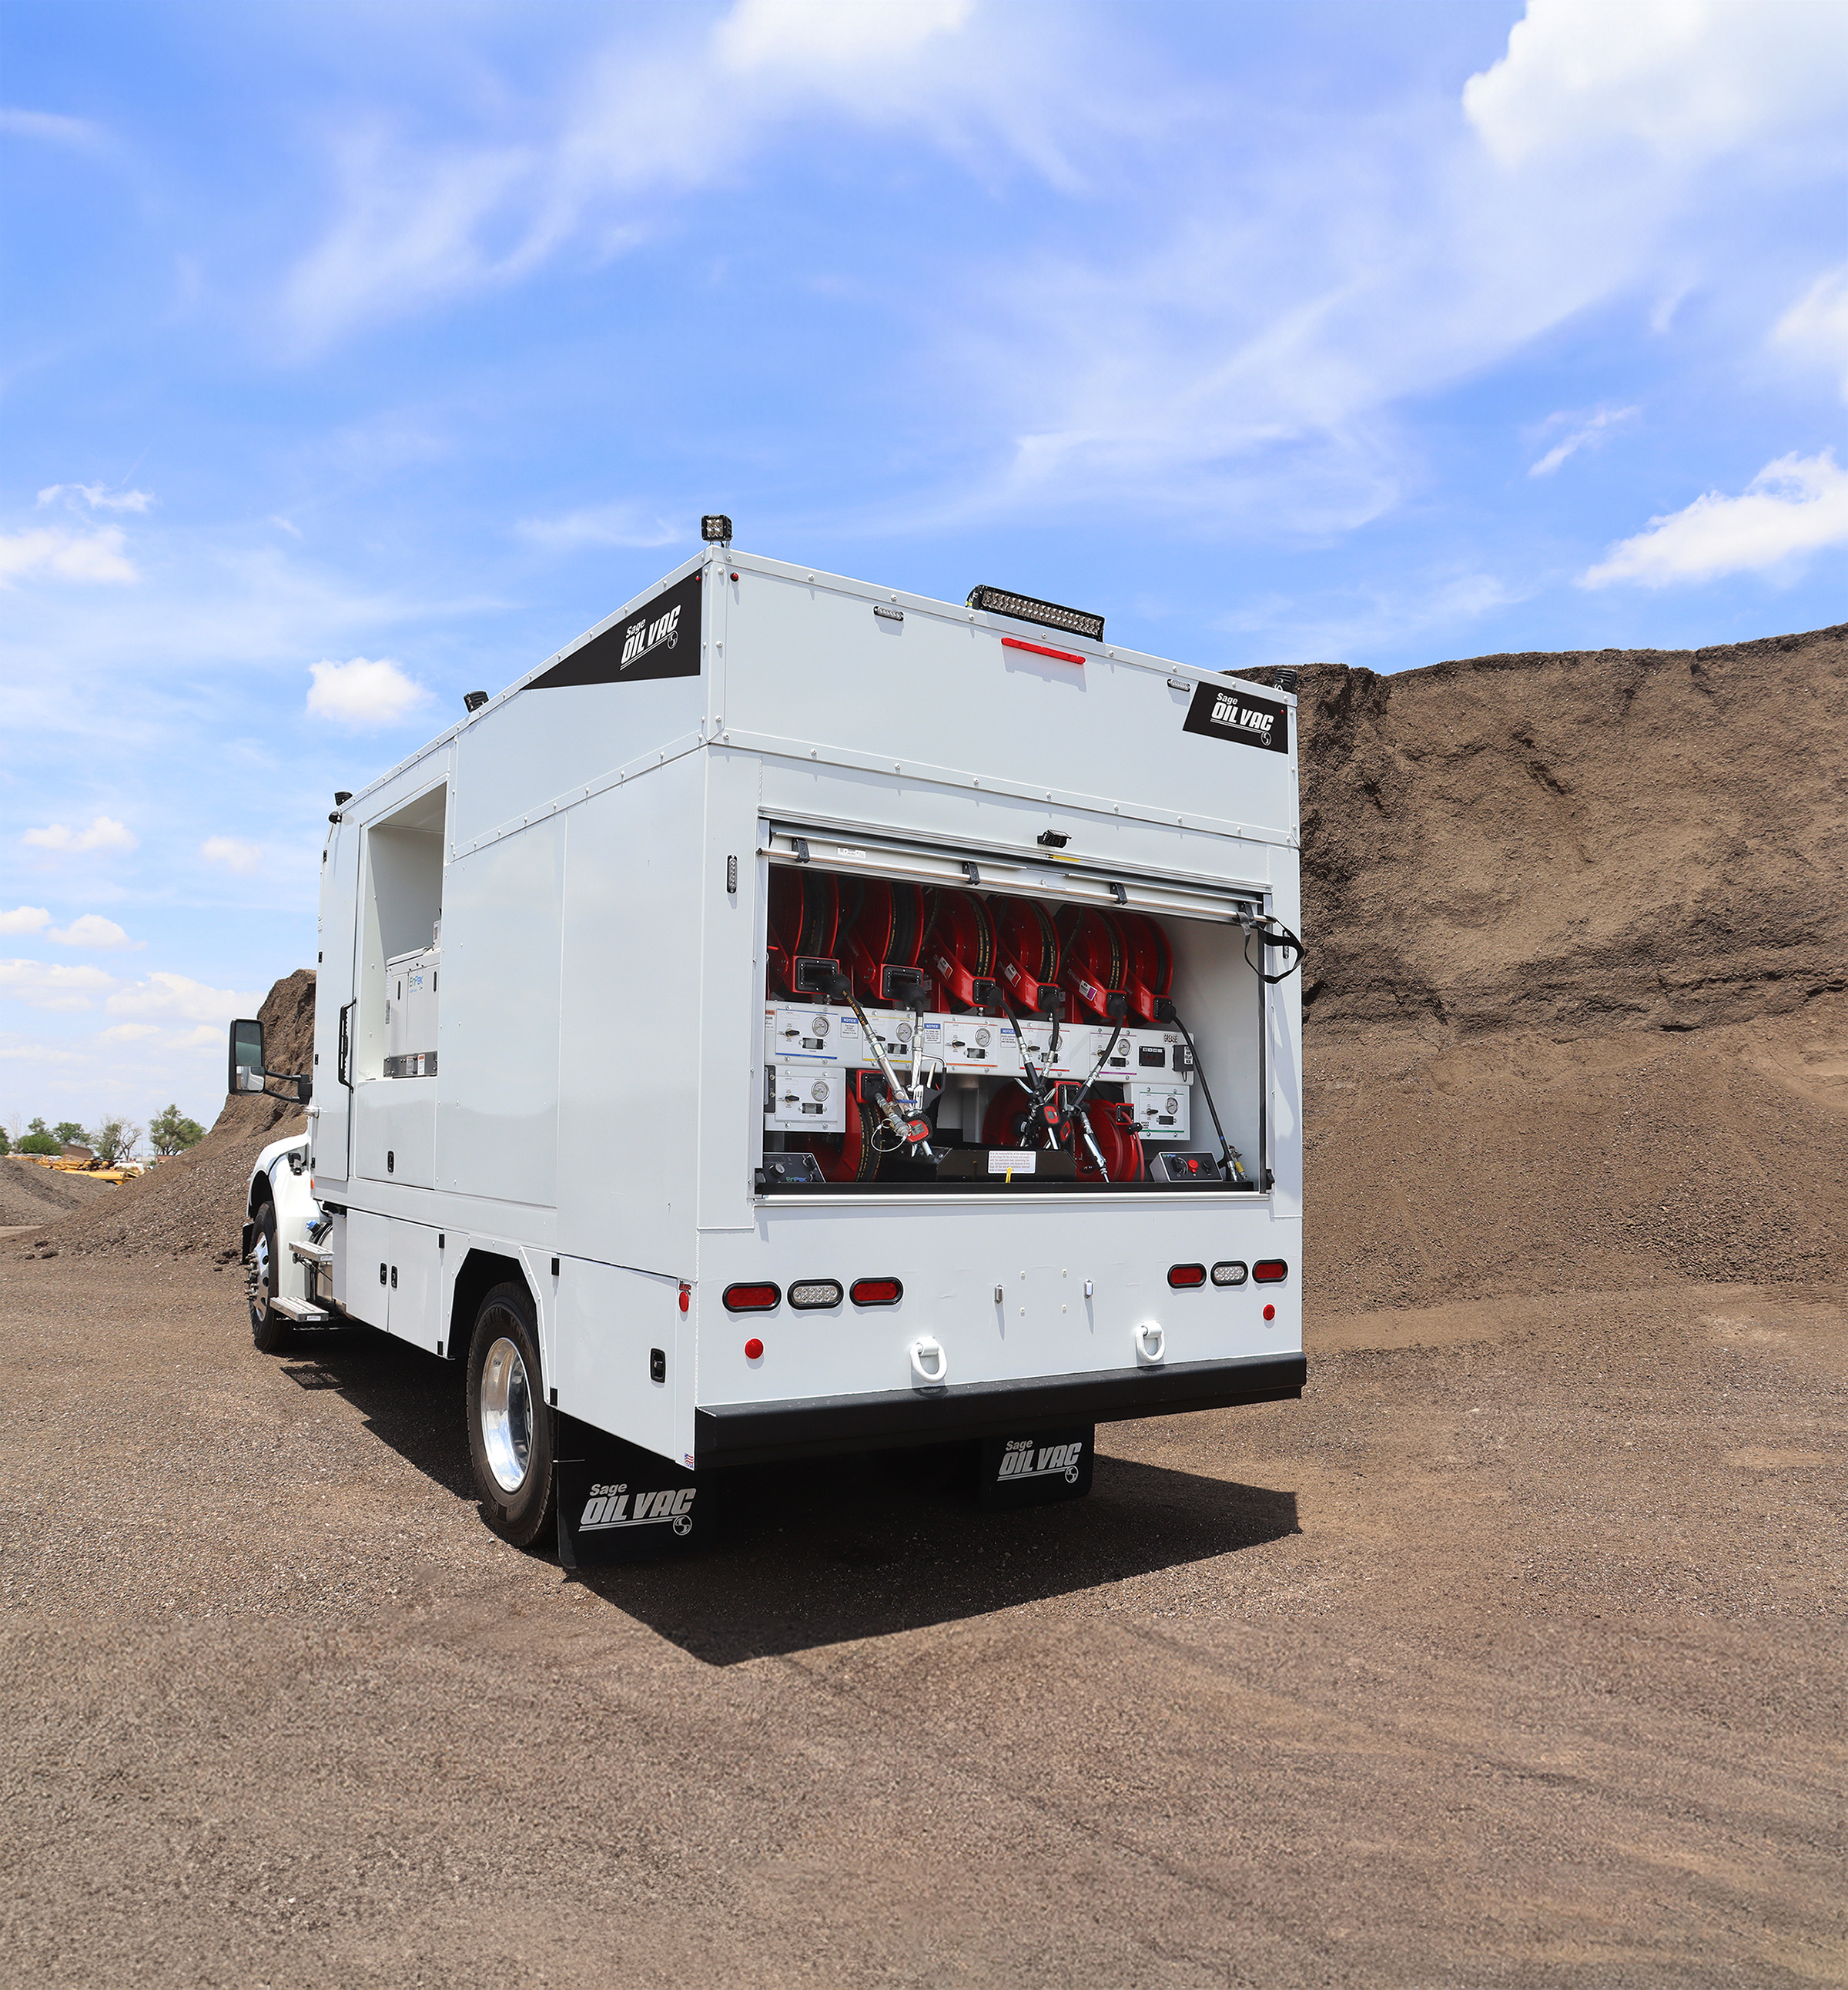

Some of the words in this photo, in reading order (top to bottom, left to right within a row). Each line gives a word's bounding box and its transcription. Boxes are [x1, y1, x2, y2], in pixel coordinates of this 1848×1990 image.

[621, 628, 646, 664] OIL
[648, 605, 681, 646] VAC
[625, 618, 646, 638] Sage
[1217, 692, 1238, 705] Sage
[1211, 702, 1238, 723] OIL
[1240, 709, 1274, 731] VAC
[1163, 1034, 1177, 1044] GREASE
[1006, 1439, 1033, 1452] Sage
[999, 1449, 1035, 1475] OIL
[1036, 1442, 1082, 1470] VAC
[590, 1483, 628, 1496] Sage
[581, 1495, 629, 1525] OIL
[632, 1488, 697, 1519] VAC
